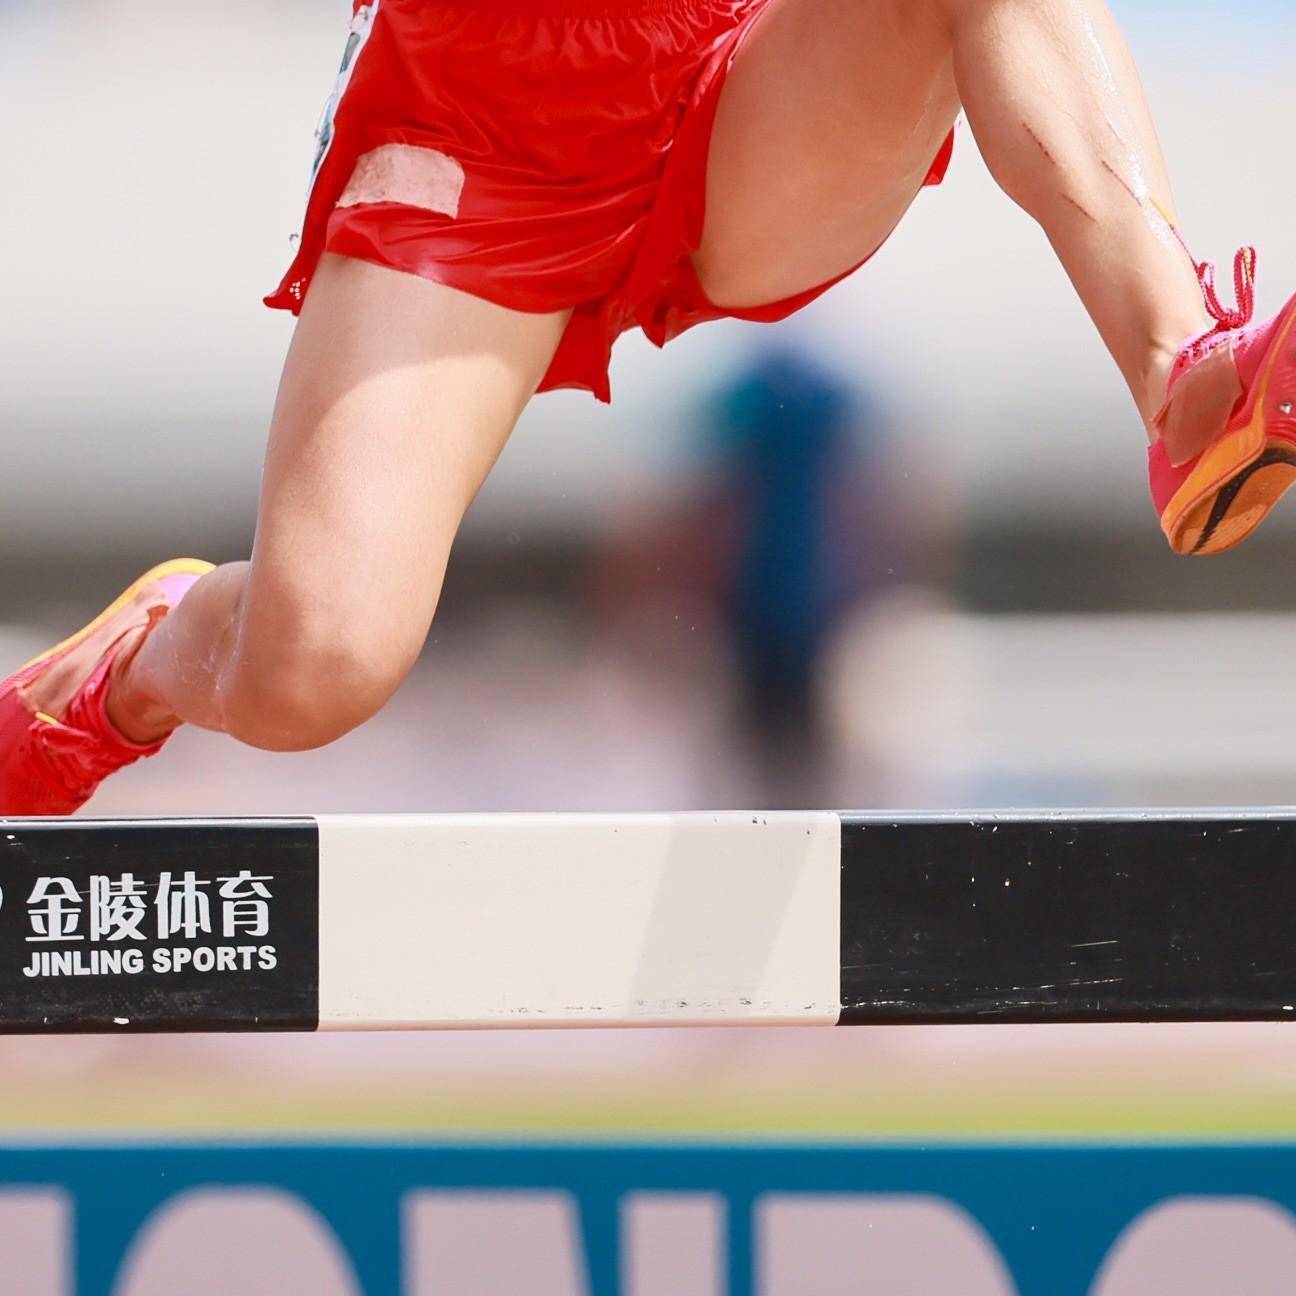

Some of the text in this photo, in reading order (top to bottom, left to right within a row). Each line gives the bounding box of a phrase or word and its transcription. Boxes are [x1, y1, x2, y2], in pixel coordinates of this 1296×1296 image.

[25, 870, 276, 943] 金陵体育
[23, 945, 277, 977] JINLING SPORTS
